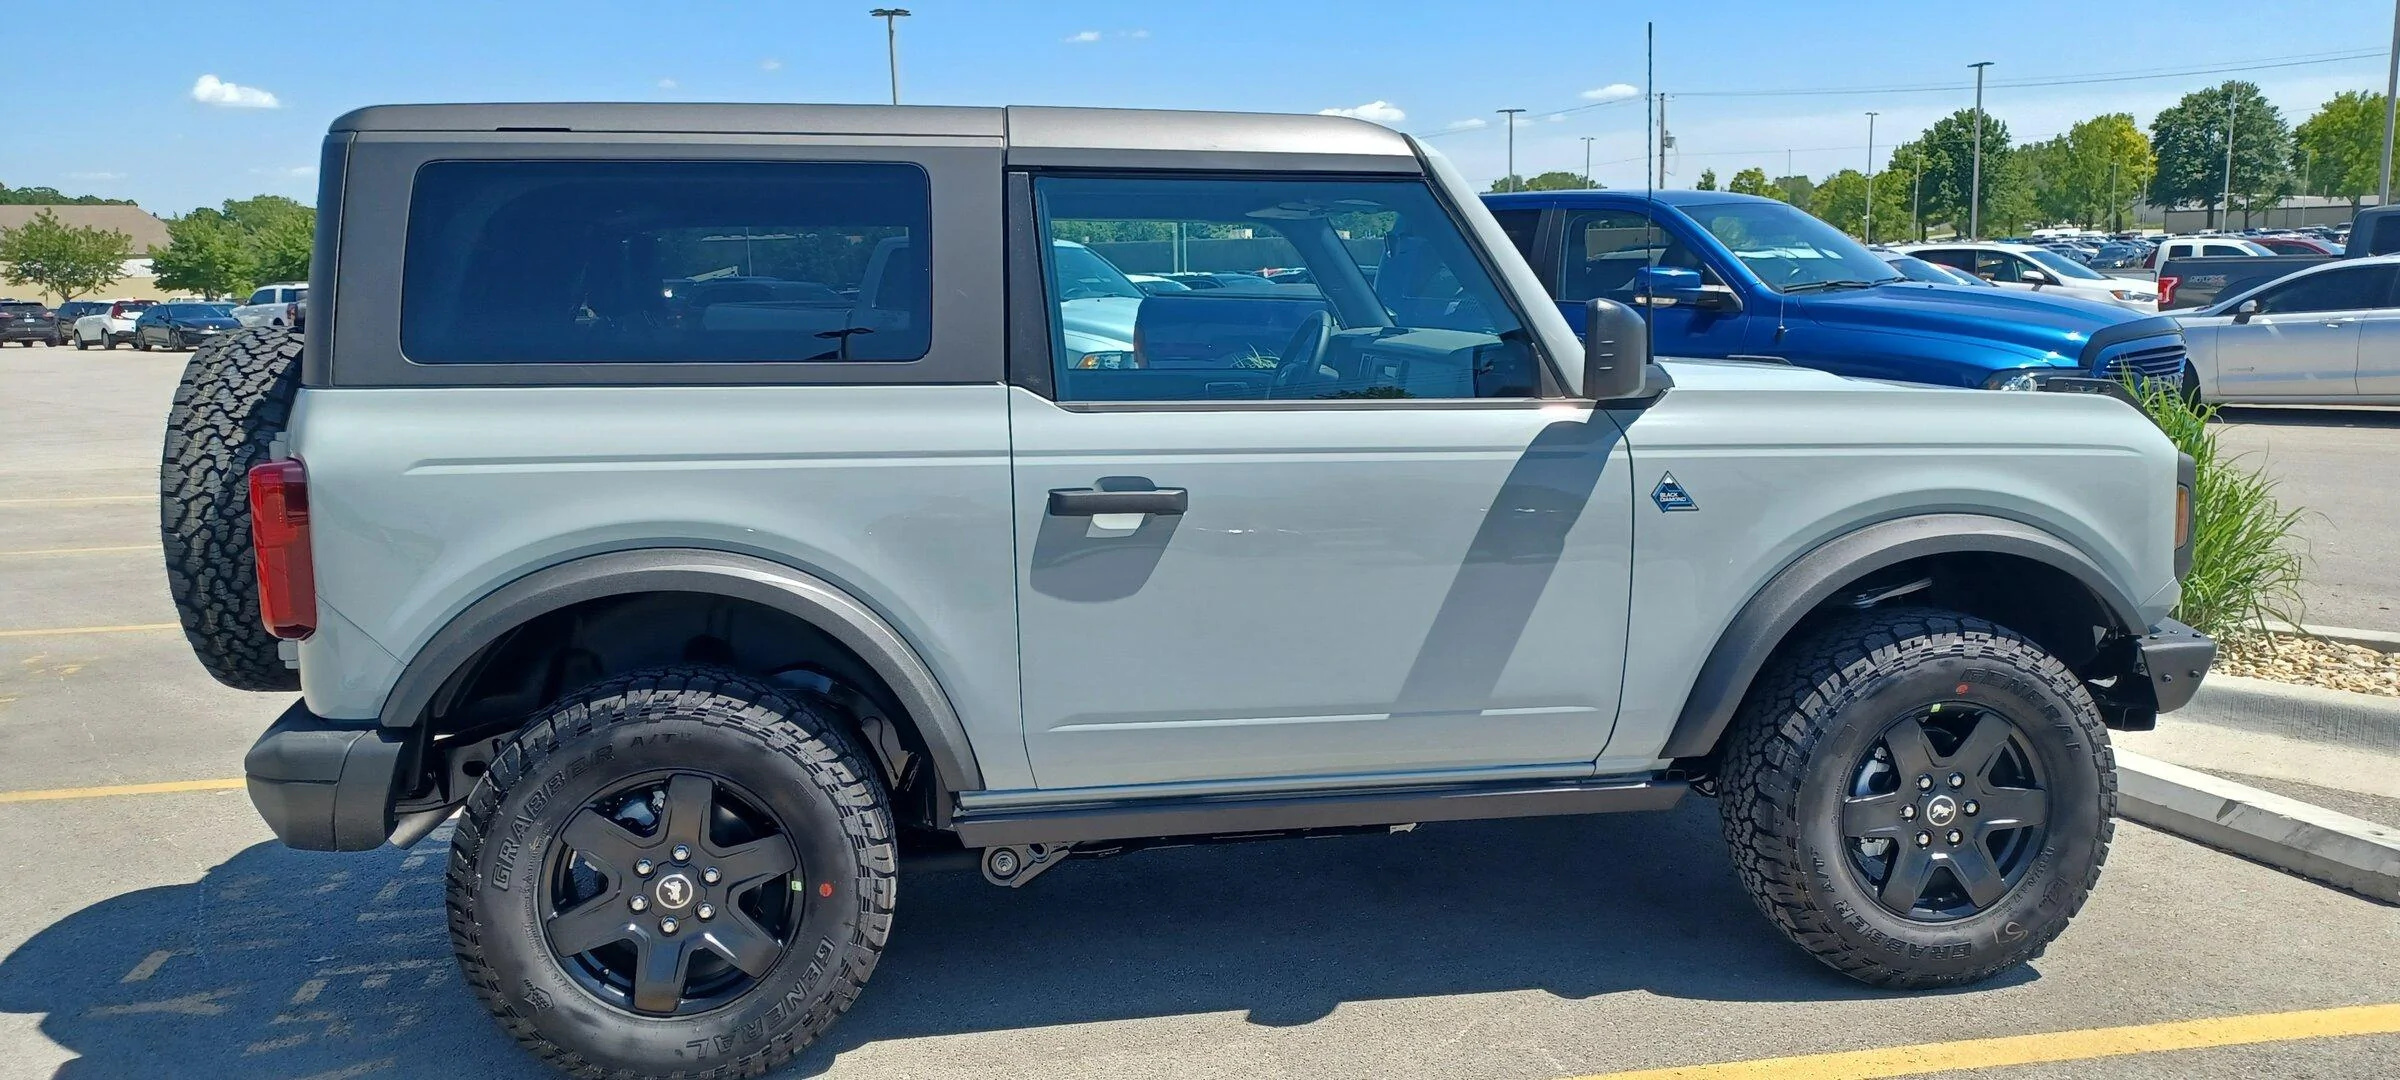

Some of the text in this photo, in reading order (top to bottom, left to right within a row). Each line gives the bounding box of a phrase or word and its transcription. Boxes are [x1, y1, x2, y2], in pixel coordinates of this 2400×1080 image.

[491, 744, 616, 891] GRABBER
[1833, 899, 1972, 960] GRABBER
[685, 935, 836, 1059] GENERAL
